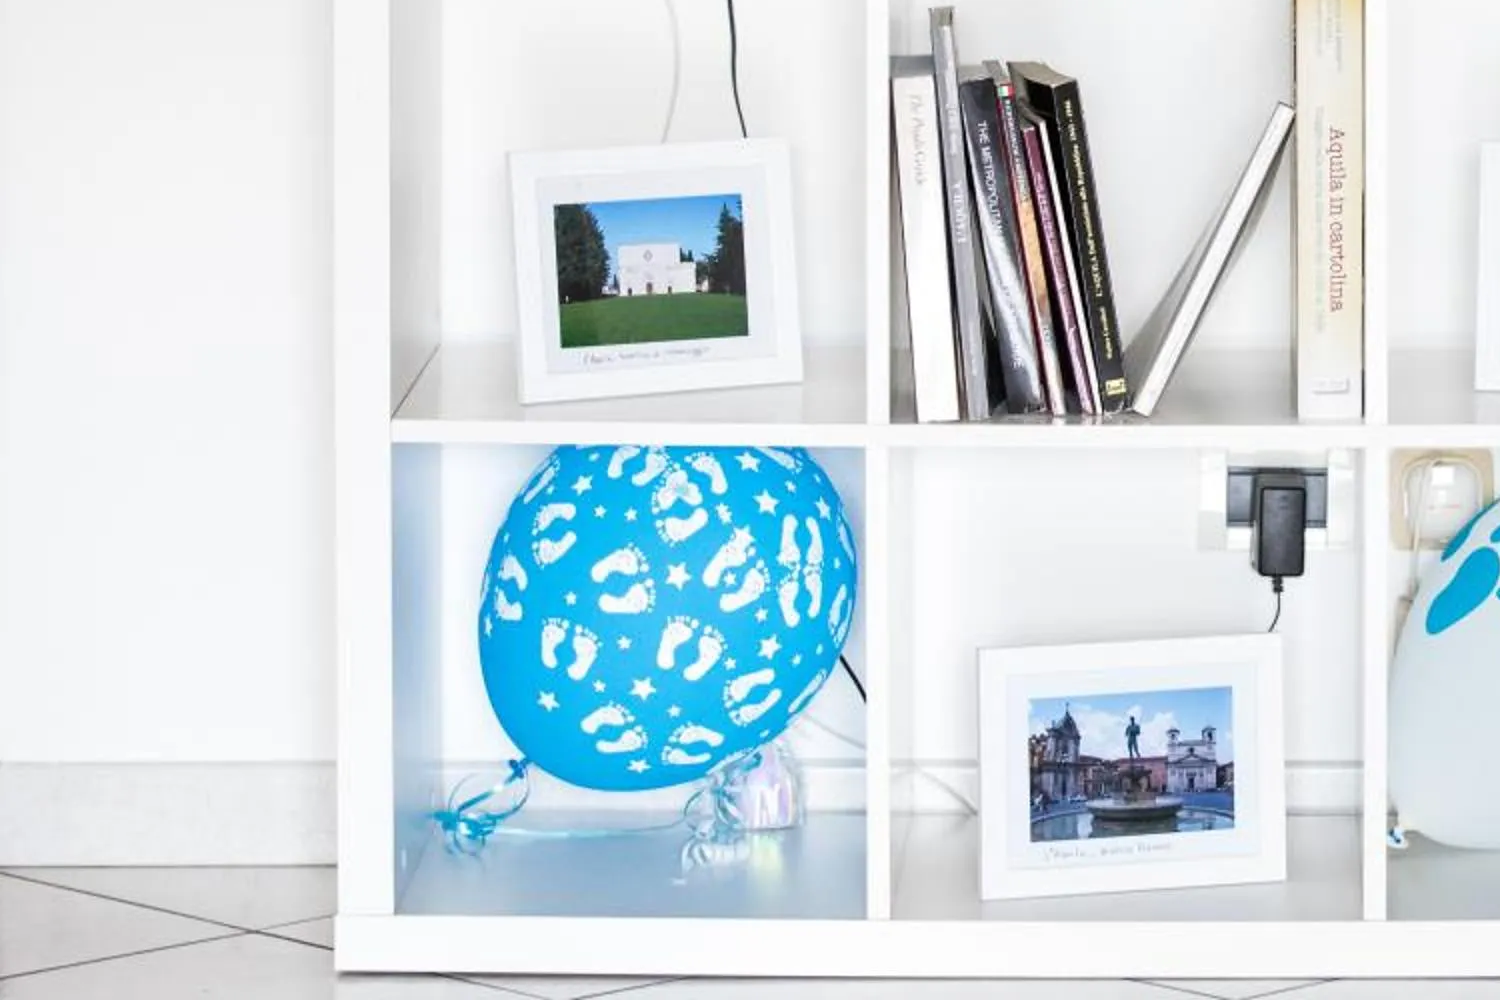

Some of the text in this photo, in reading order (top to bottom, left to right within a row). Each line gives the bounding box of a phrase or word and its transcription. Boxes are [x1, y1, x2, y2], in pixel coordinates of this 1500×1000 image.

[976, 119, 990, 144] THE
[1327, 127, 1348, 312] Aquila in cartolina
